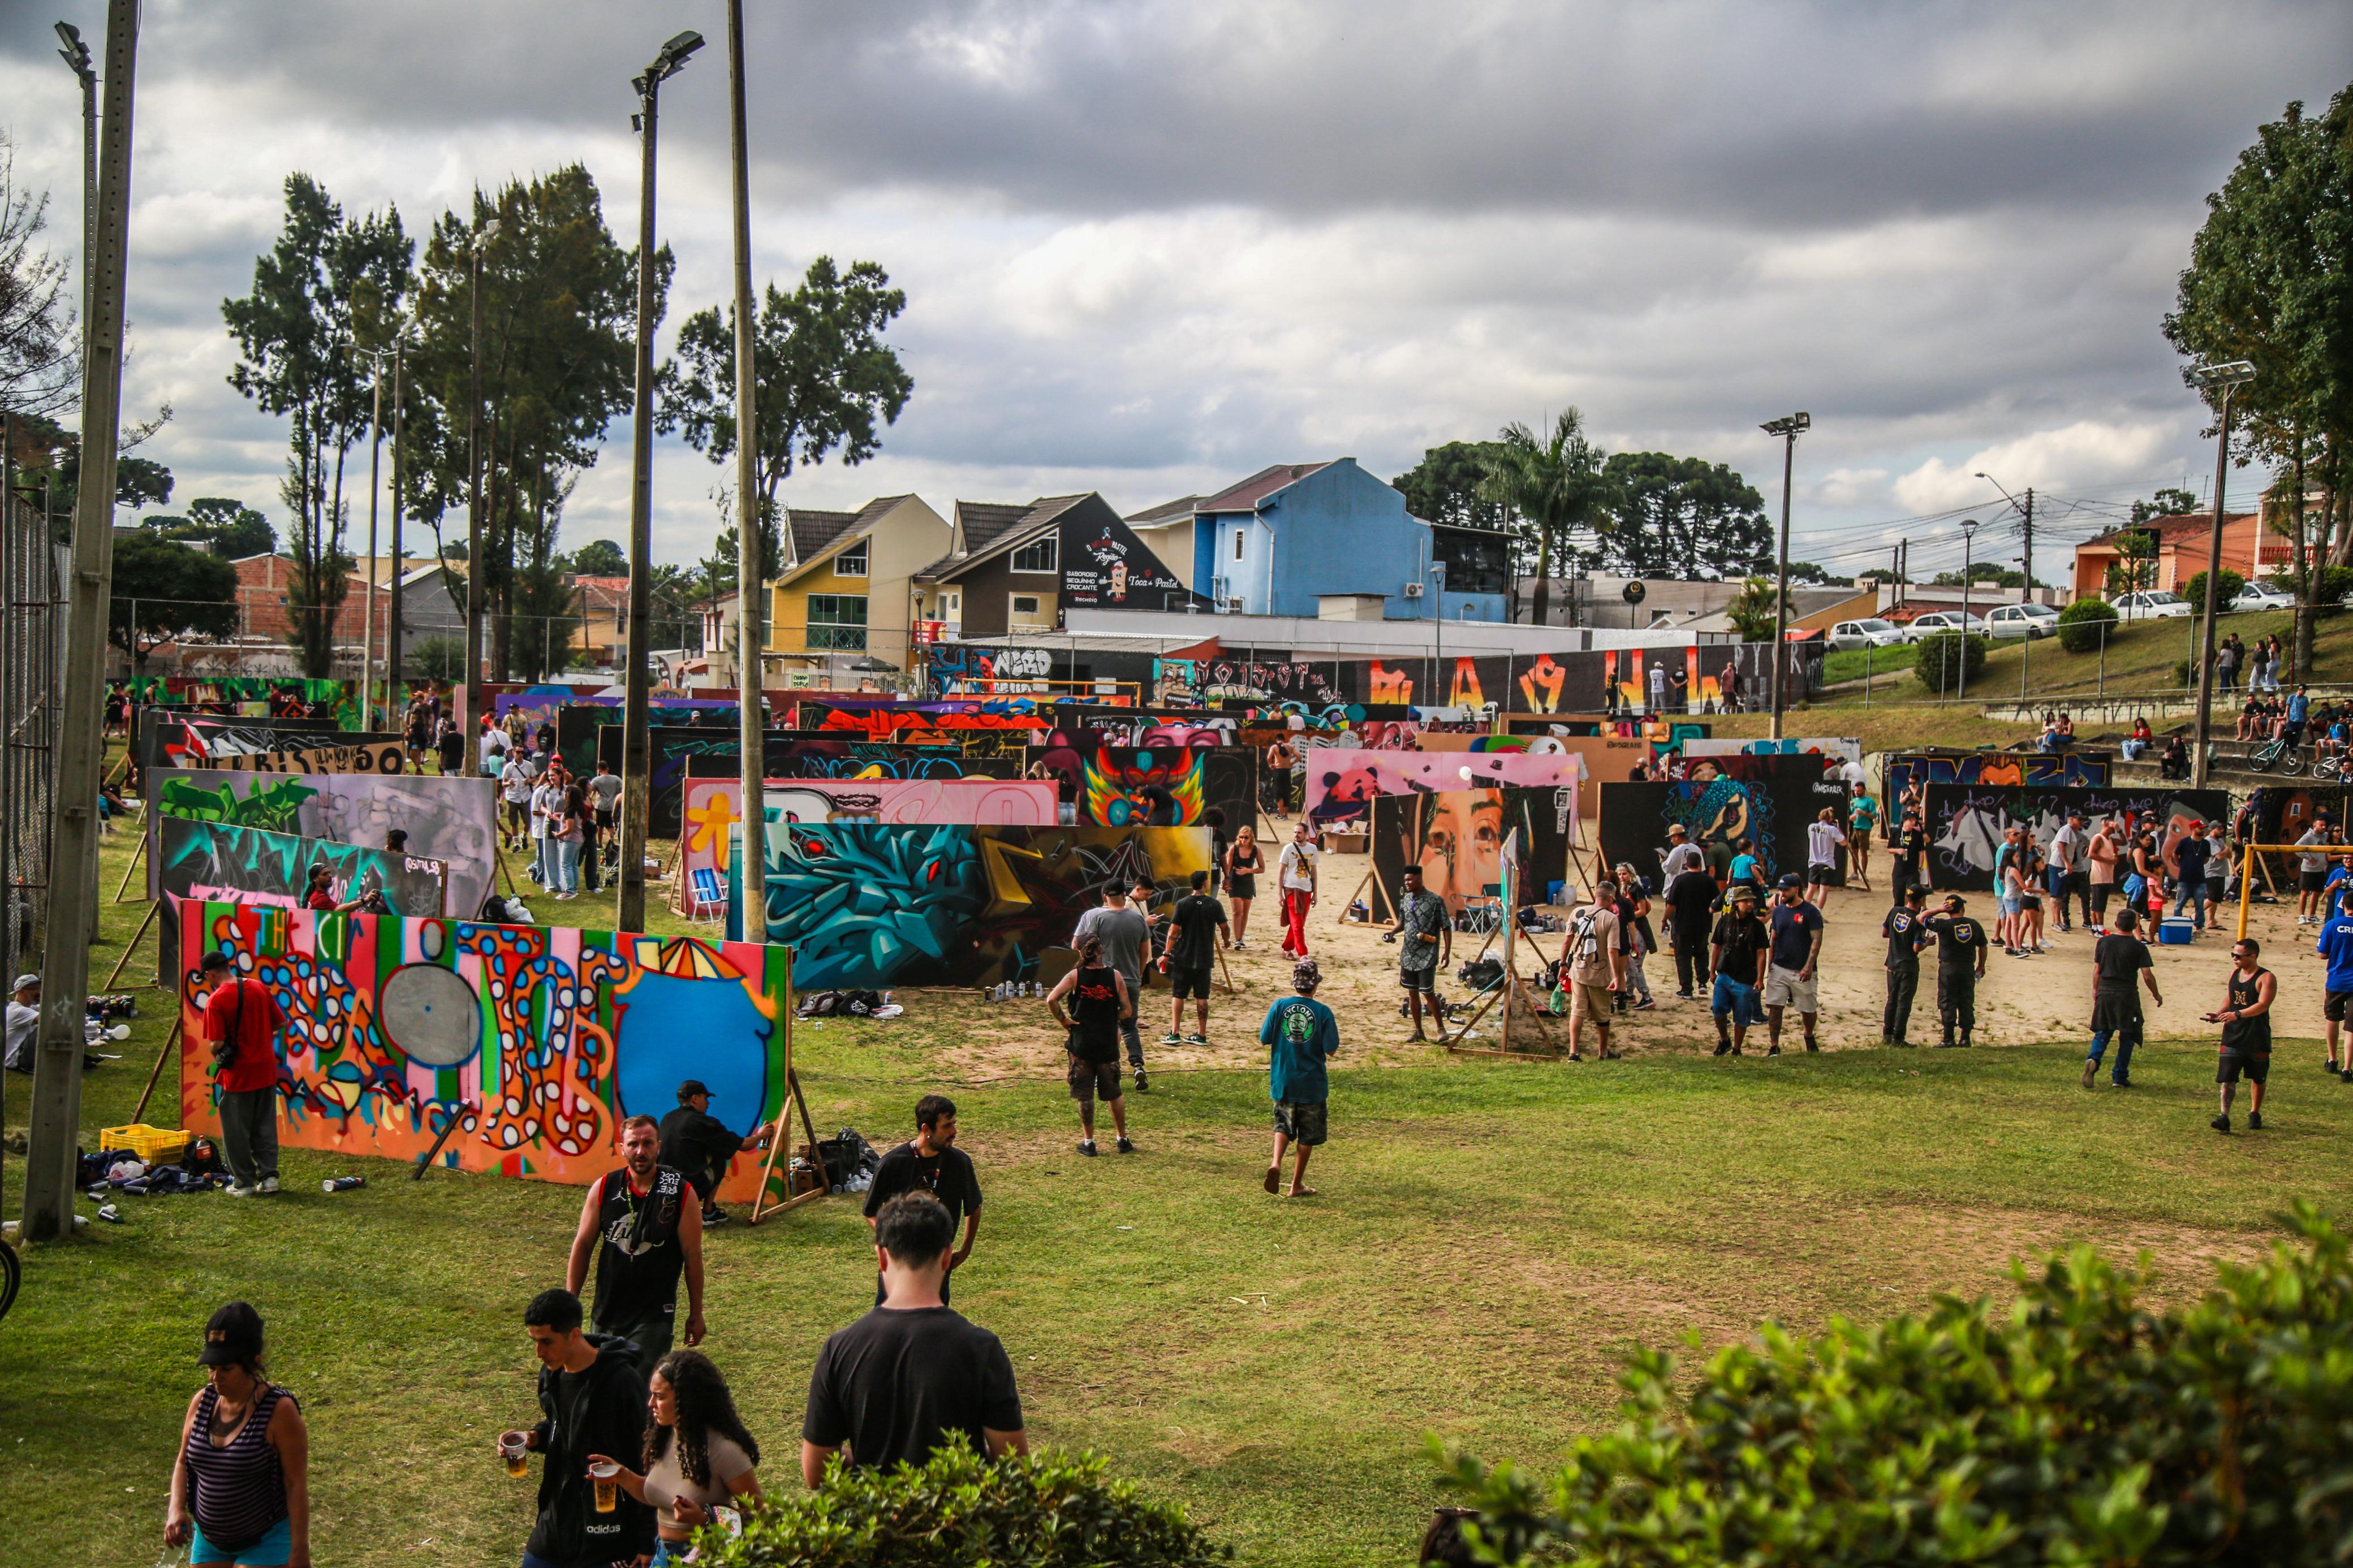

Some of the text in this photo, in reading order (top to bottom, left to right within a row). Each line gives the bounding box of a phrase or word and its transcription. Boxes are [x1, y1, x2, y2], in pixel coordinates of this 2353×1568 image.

[1111, 541, 1128, 556] PASTEL
[1093, 552, 1122, 565] Região
[1128, 574, 1148, 586] Toca
[1156, 577, 1179, 588] Pastel
[1284, 1006, 1314, 1021] CYCLONE
[587, 1524, 620, 1534] adidas
